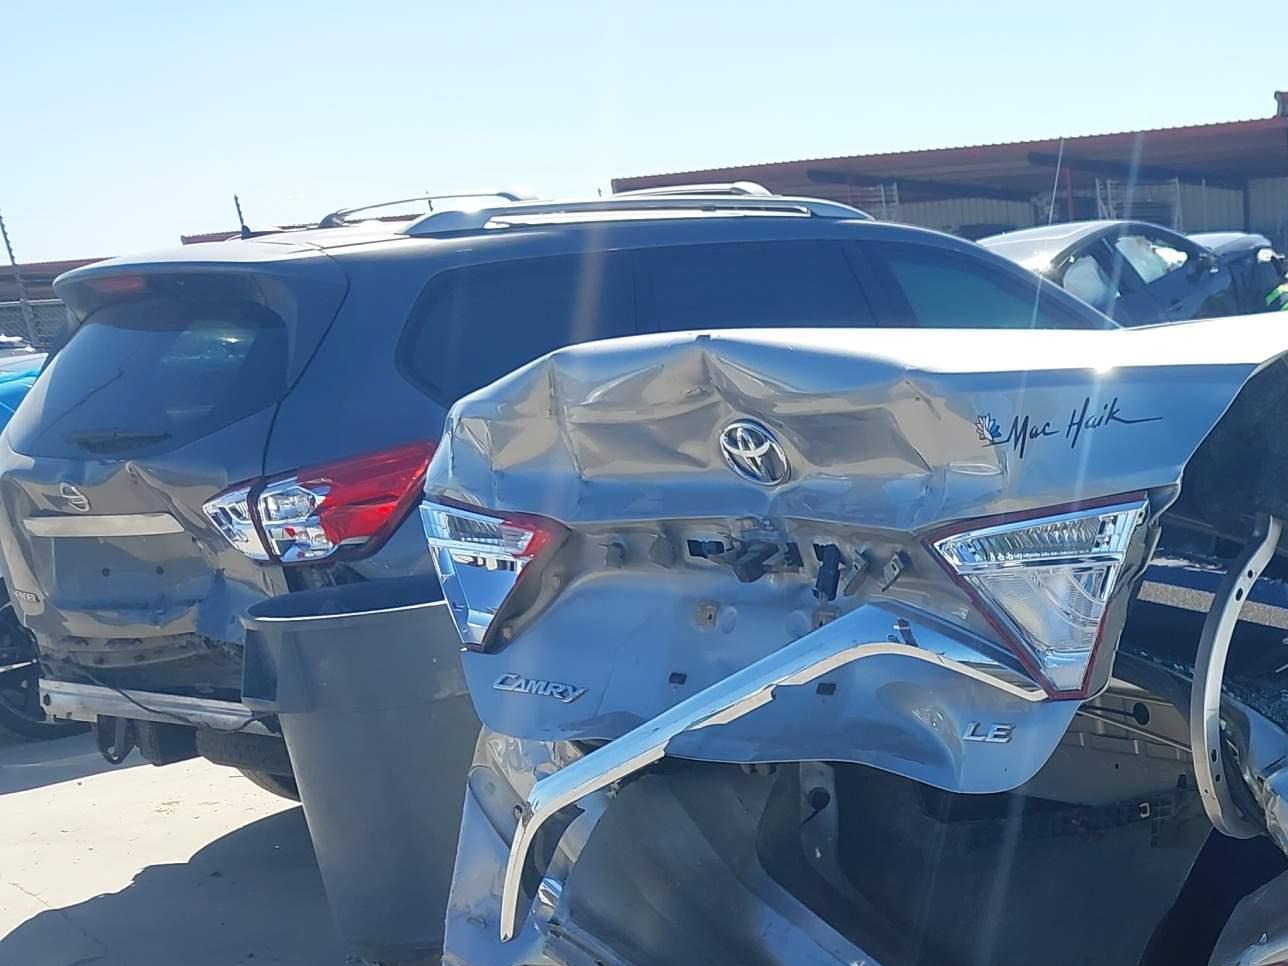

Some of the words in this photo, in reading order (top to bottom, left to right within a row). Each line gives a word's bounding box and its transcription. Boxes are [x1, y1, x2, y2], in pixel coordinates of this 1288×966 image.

[1000, 415, 1060, 459] Mac
[1066, 397, 1163, 449] Haik
[493, 673, 589, 704] CAMRY
[962, 720, 1016, 744] LE
